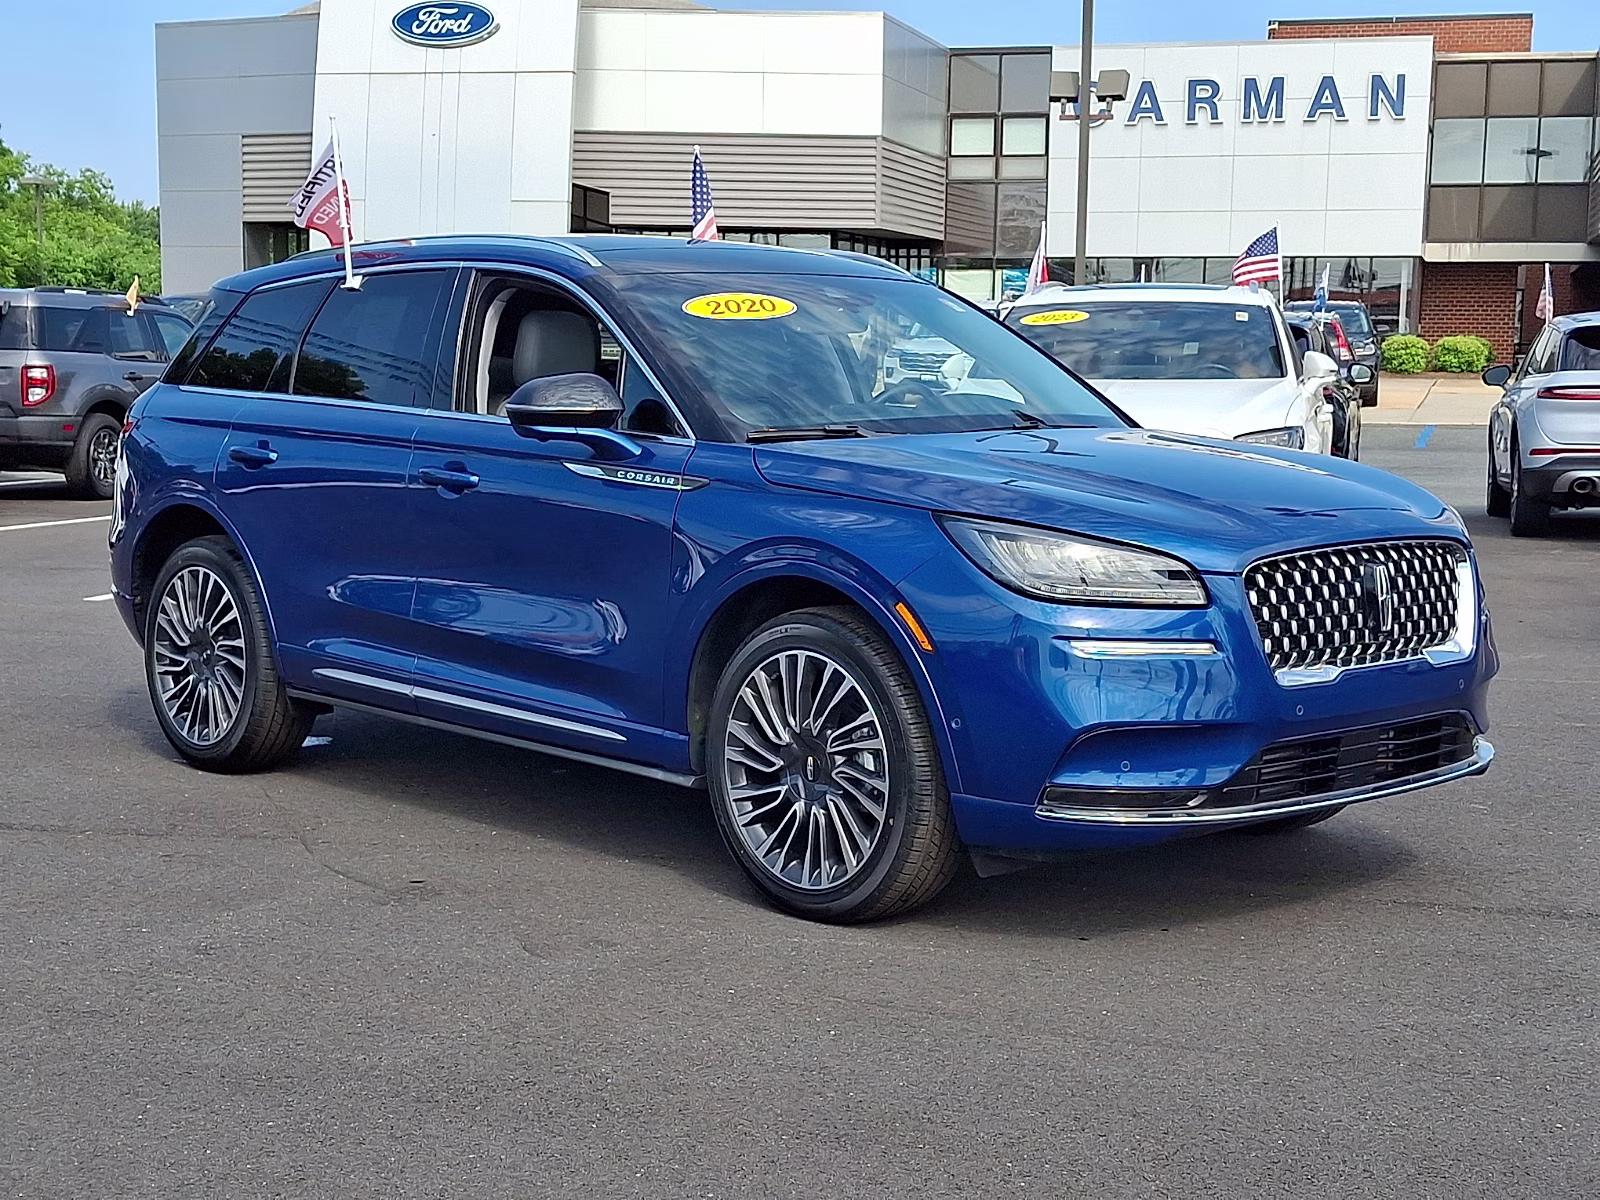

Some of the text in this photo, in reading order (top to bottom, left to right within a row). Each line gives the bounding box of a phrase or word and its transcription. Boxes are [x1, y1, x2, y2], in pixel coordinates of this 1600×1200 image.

[411, 7, 474, 34] Ford
[705, 298, 777, 315] 2020
[617, 470, 676, 485] CORSAIR
